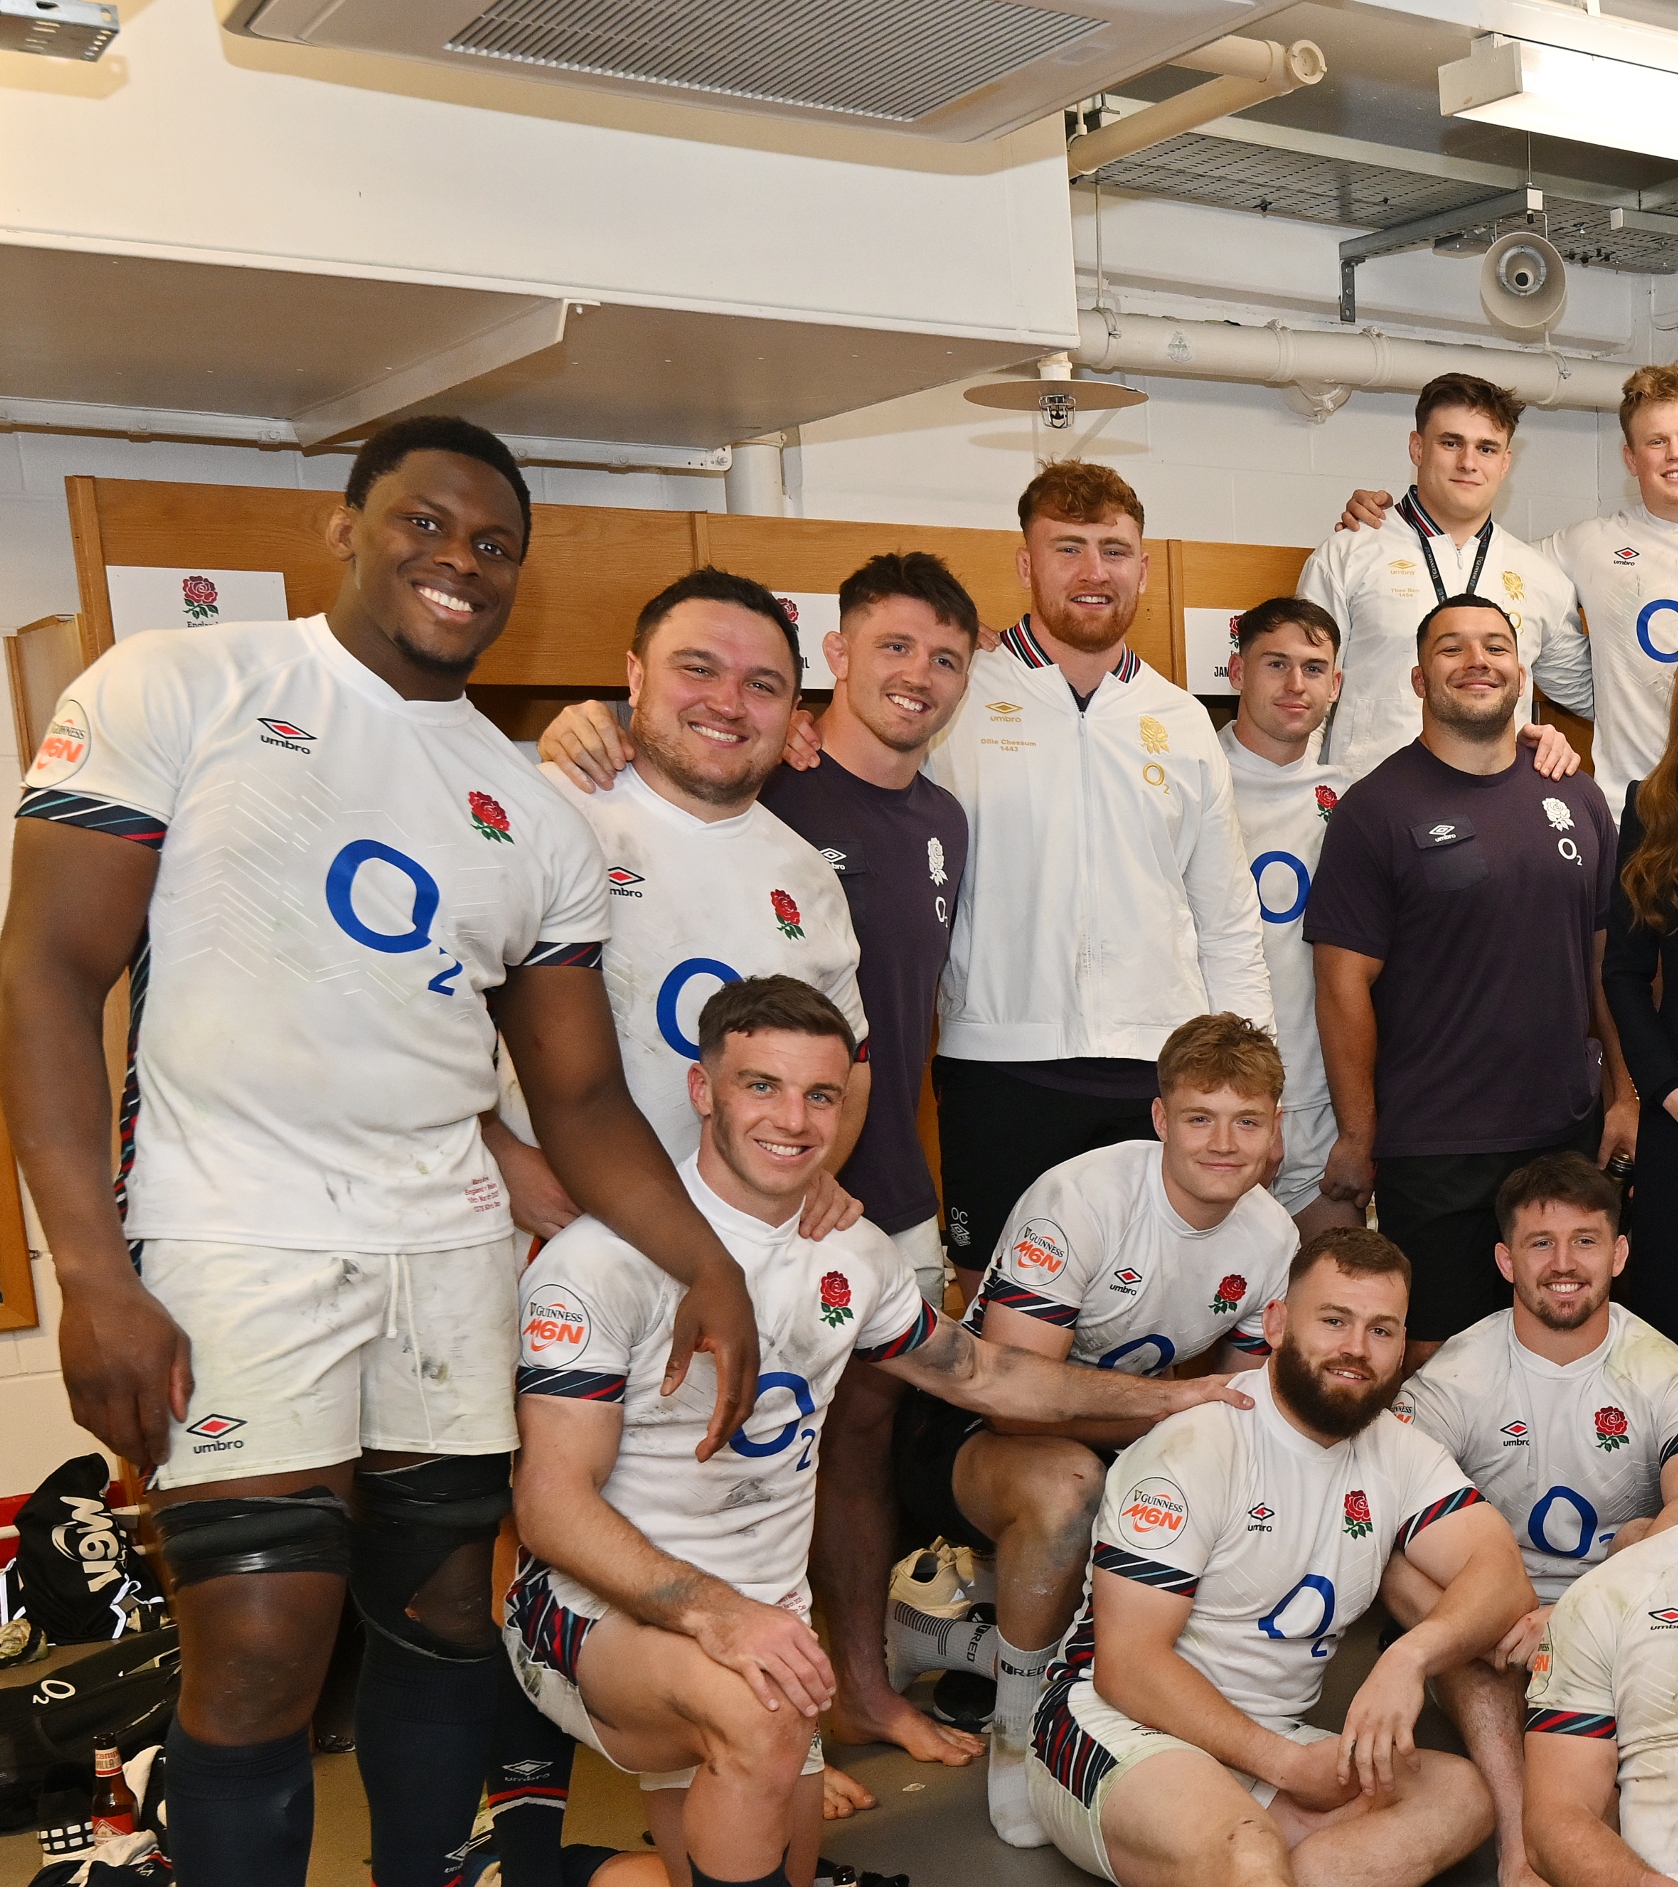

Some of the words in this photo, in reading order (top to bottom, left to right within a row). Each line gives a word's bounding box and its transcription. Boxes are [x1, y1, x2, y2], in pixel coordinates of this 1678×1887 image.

[260, 734, 311, 755] umbro
[1435, 834, 1456, 842] umbro
[1558, 838, 1583, 865] O2
[608, 887, 642, 898] mbro
[326, 839, 463, 996] O2
[1029, 1232, 1063, 1258] GUINNESS
[1109, 1284, 1136, 1296] umbro
[534, 1306, 581, 1323] GUINNESS
[192, 1440, 243, 1454] umbro
[1139, 1495, 1182, 1513] GUINNESS
